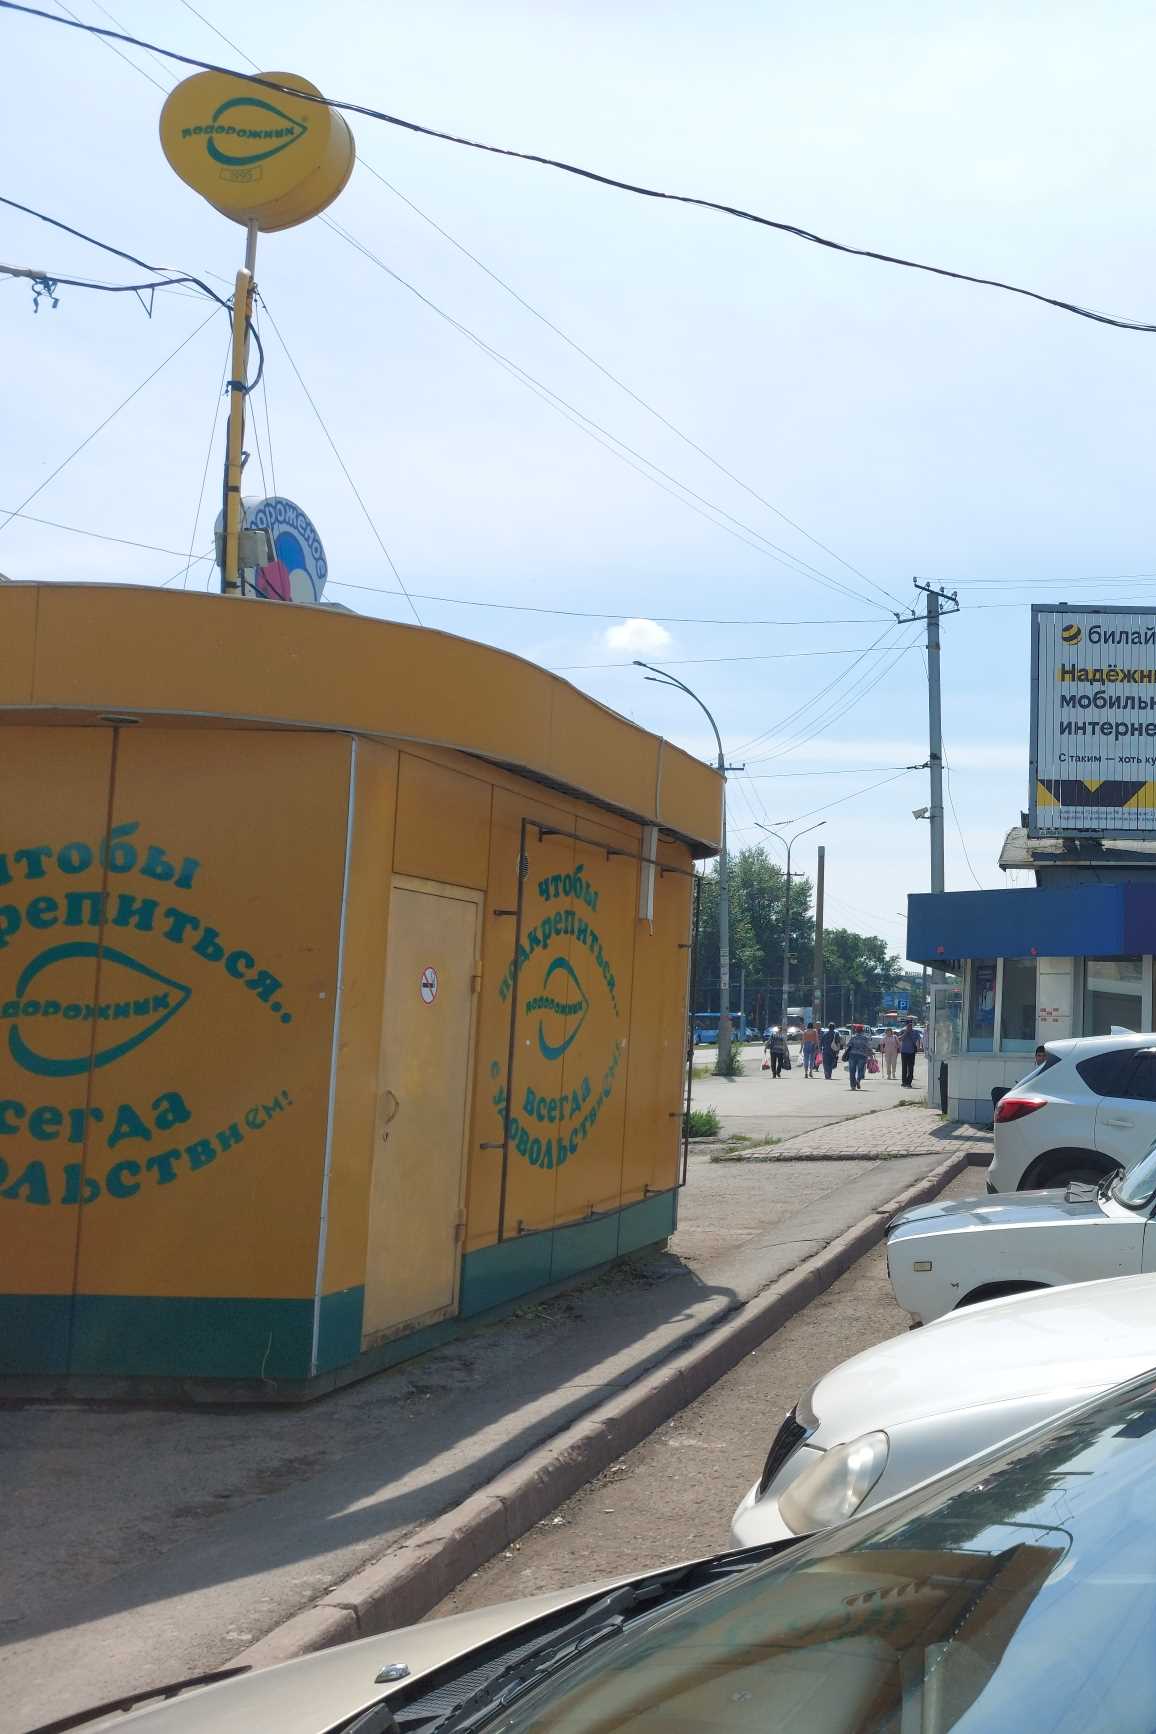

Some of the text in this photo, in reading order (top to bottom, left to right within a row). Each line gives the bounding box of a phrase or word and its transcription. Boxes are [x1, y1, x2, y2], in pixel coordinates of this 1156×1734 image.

[1058, 753, 1067, 763] С
[1069, 754, 1102, 764] таким
[1118, 755, 1142, 765] хоть
